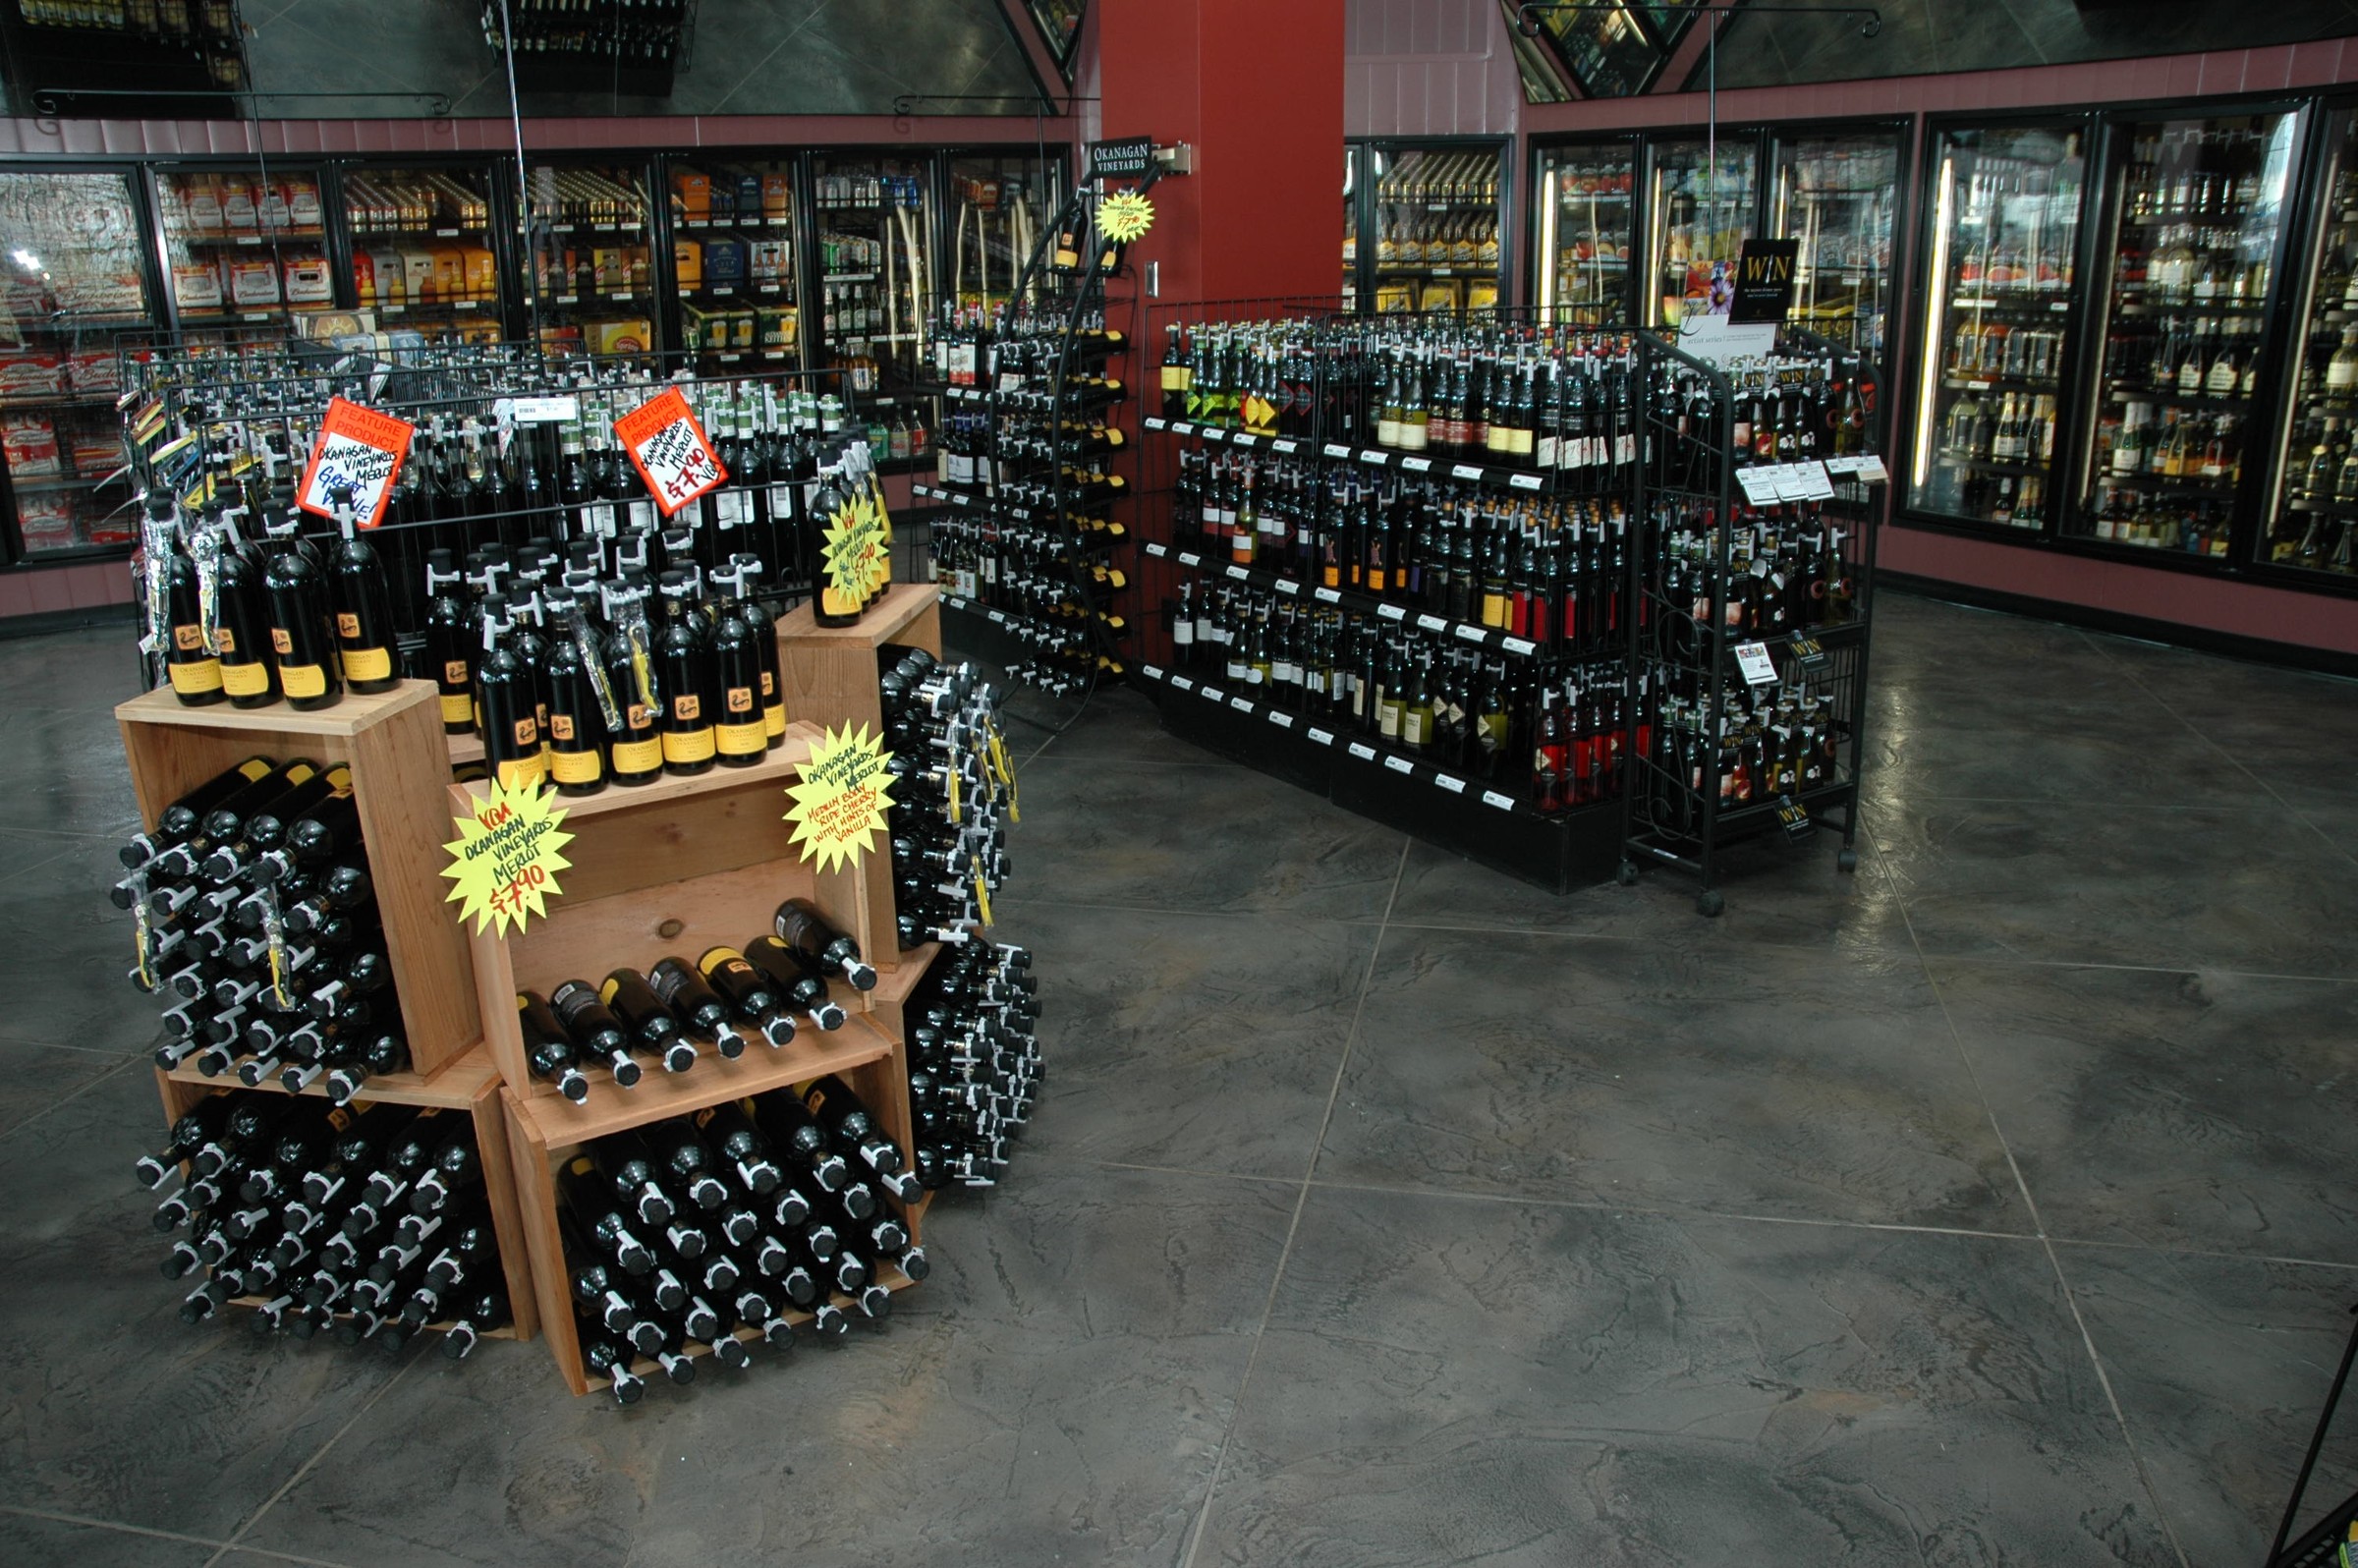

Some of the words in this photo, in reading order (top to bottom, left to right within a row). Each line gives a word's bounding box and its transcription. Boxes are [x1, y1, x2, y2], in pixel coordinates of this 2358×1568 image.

[1095, 143, 1148, 161] OKANAGAN
[1097, 159, 1146, 171] VINEYARDS
[1747, 254, 1791, 284] WIN
[340, 407, 402, 437] FEATURE
[624, 395, 674, 431] FEATURE
[632, 407, 679, 443] PRODUCT
[335, 420, 398, 450] PRODUCT
[669, 426, 694, 470] MERLOT
[345, 450, 398, 471] VINEYARDS
[355, 466, 395, 491] MERLOT
[1791, 639, 1822, 655] WIN
[808, 744, 857, 784] OKANAGAN
[826, 750, 873, 787] VINEYARDS
[845, 760, 879, 793] MERLOT
[819, 809, 840, 826] RIPE
[842, 787, 877, 812] CHERRY
[841, 782, 866, 801] BODY
[814, 822, 840, 843] WITH
[840, 808, 865, 825] HINTS
[866, 801, 877, 812] OF
[1779, 804, 1807, 821] WIN
[465, 813, 526, 861] OKANAGAN
[492, 816, 553, 862] VINEYARDS
[835, 815, 871, 843] VANILLA
[493, 841, 541, 885] MERLOT
